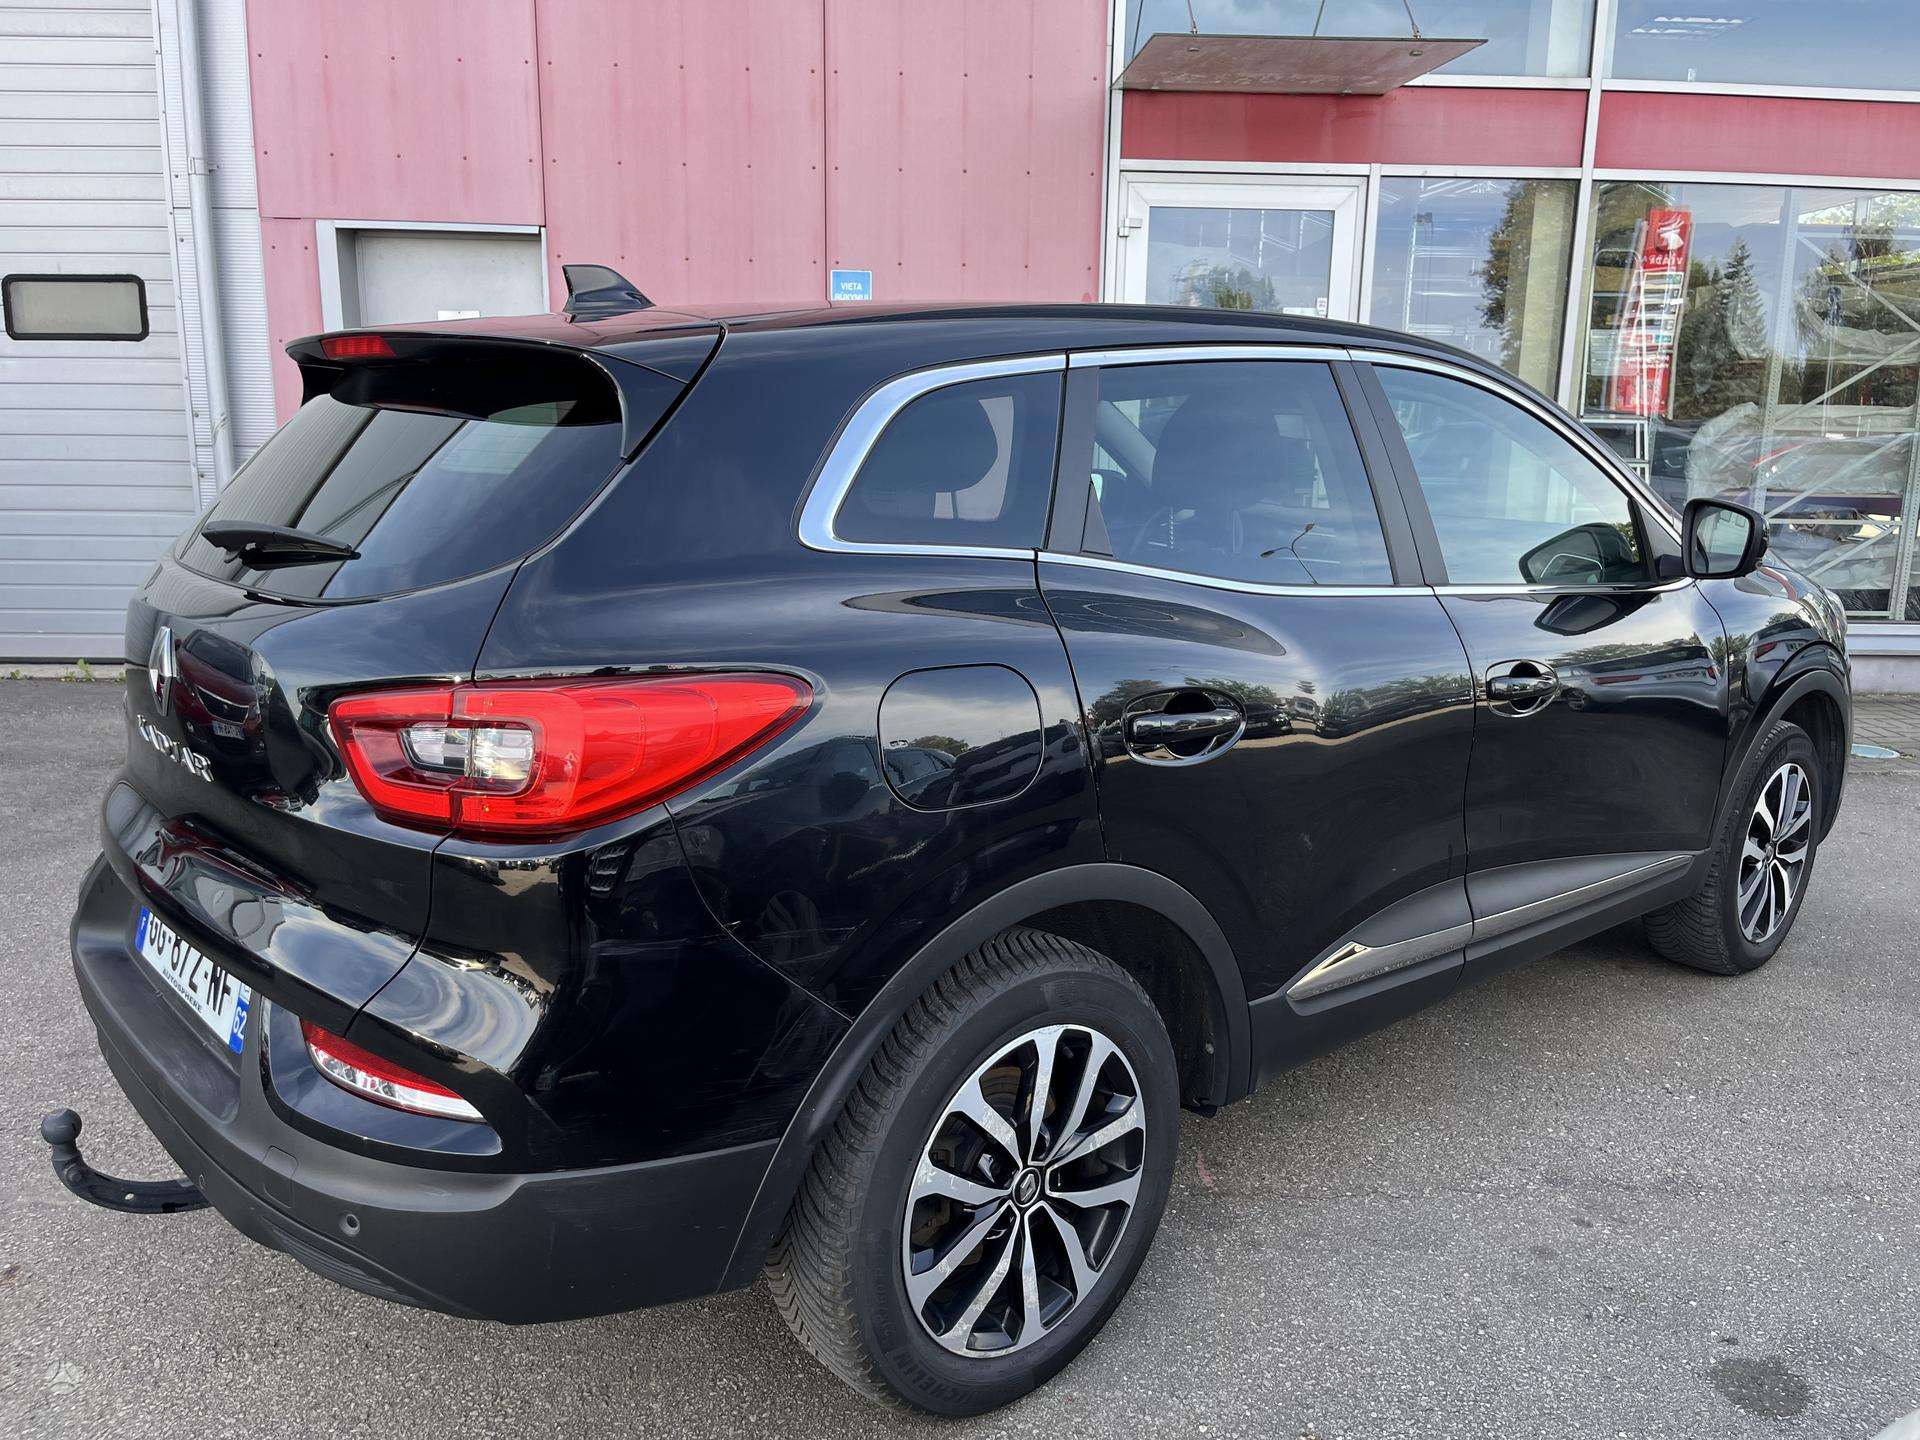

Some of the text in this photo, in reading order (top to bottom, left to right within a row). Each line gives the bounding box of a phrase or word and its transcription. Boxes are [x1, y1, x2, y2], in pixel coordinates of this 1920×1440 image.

[840, 281, 863, 291] VIETA
[162, 967, 203, 1014] AUTOSPHERE
[233, 1005, 248, 1040] 62
